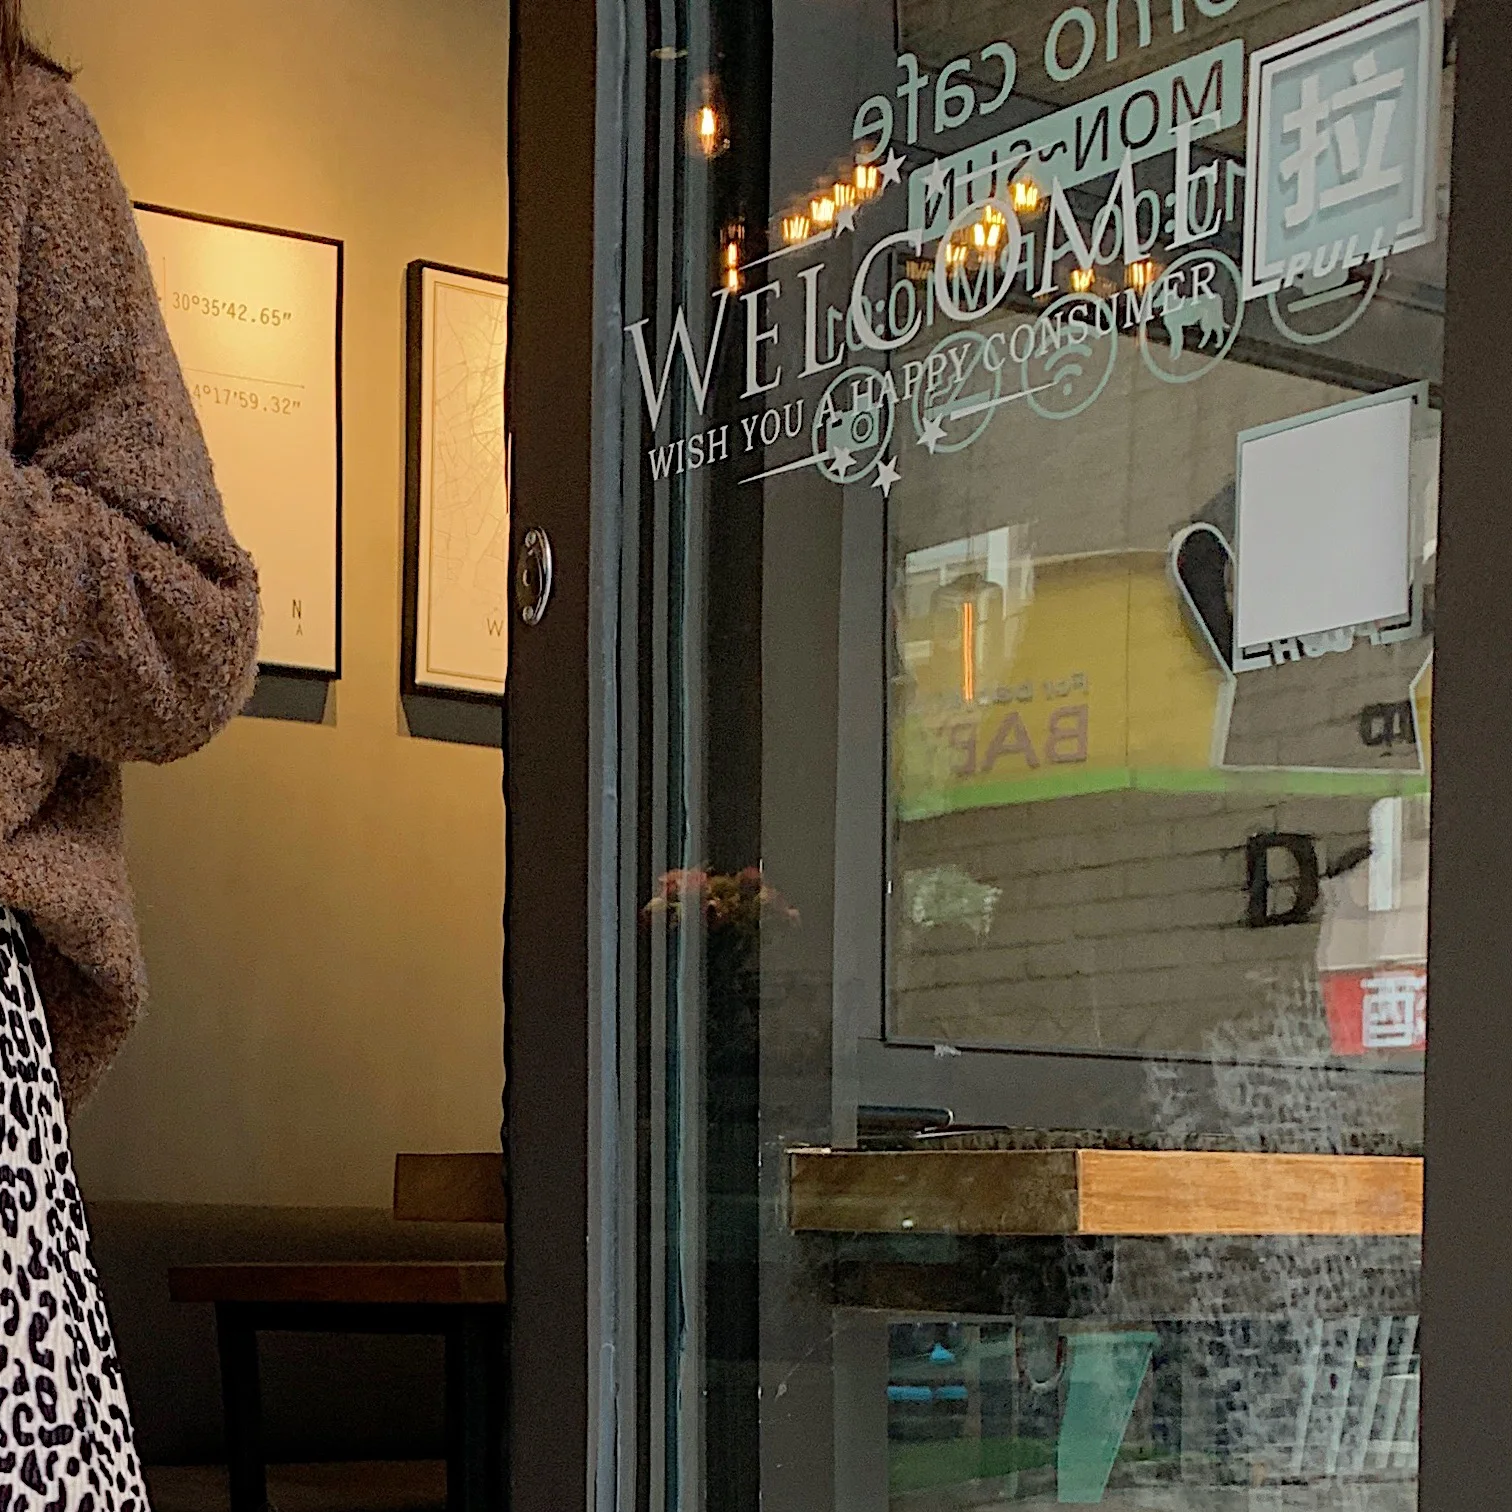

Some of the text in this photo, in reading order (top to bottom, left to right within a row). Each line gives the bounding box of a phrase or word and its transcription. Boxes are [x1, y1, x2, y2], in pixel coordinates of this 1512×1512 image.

[1279, 49, 1404, 228] 拉
[624, 108, 1223, 433] WELCOME
[1283, 226, 1394, 289] PULL
[648, 260, 1219, 482] WISH YOU A HAPPY CONSUMER
